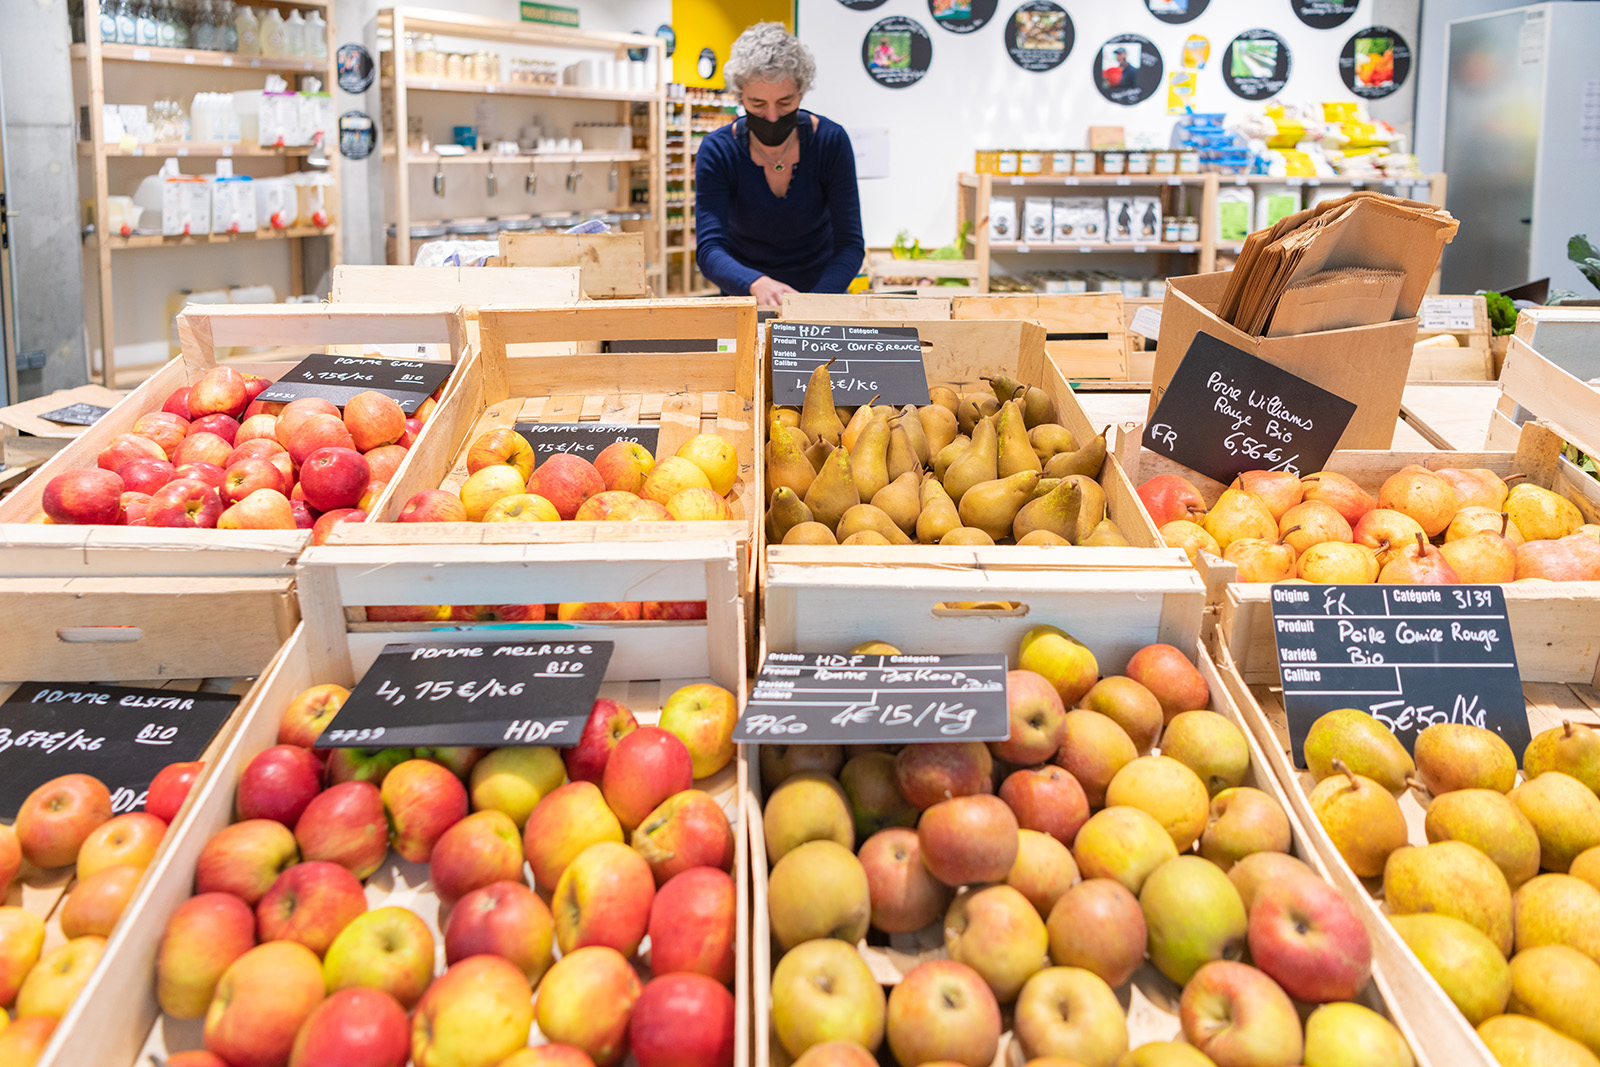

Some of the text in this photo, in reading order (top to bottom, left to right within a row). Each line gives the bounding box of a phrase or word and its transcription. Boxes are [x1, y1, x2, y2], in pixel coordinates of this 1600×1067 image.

[773, 324, 796, 332] Origine
[799, 325, 831, 337] HDF
[774, 350, 797, 358] Variété
[390, 360, 424, 369] GALA
[1206, 371, 1313, 431] Poire Williams
[1151, 423, 1178, 452] FR
[1265, 419, 1293, 443] Bio
[1274, 589, 1310, 603] Origine
[1393, 589, 1442, 603] Catégorie
[1452, 590, 1492, 609] 3139
[1277, 620, 1315, 633] Produit
[1395, 621, 1444, 644] Comice
[1451, 622, 1500, 652] Rouge
[768, 653, 940, 668] Origine HDF Catégorie
[1280, 646, 1384, 665] Variété Bio
[762, 667, 801, 676] Produit
[1284, 668, 1321, 682] Calibre
[757, 680, 795, 689] Variété
[753, 690, 793, 699] Calibre
[503, 719, 569, 742] HDF
